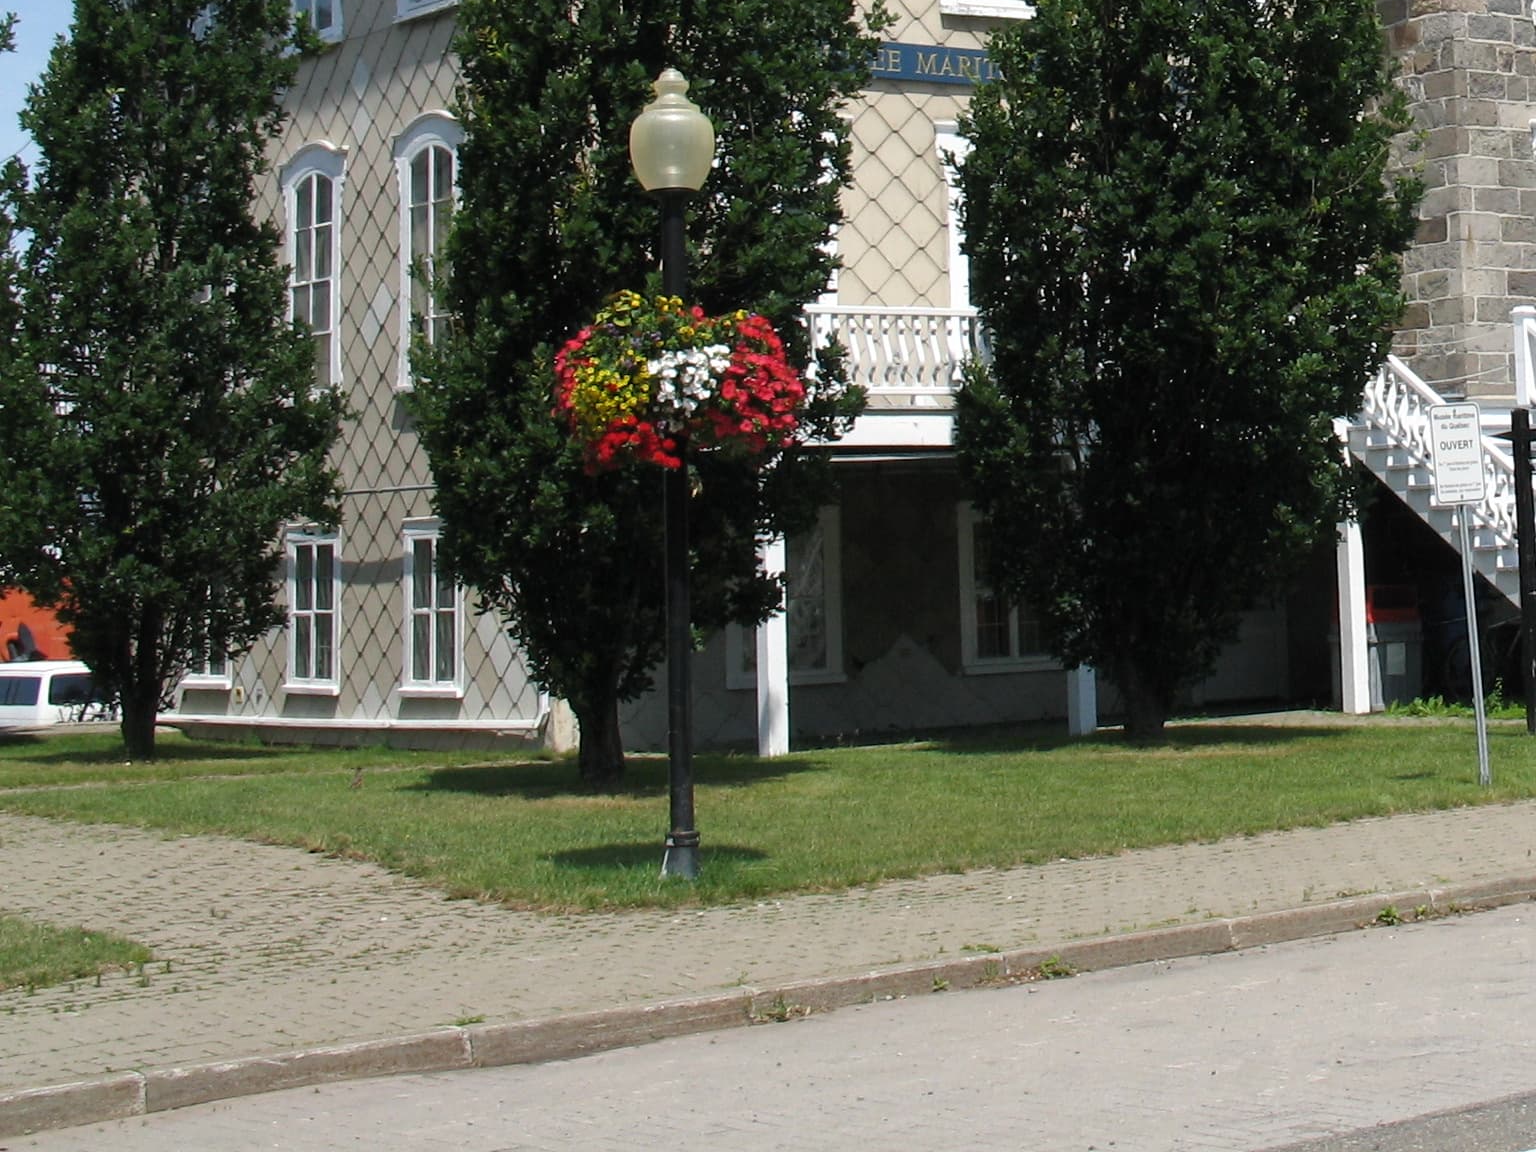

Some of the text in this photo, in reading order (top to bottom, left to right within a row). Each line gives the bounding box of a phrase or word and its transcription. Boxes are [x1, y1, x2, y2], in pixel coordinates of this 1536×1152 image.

[870, 48, 1007, 82] EE MARIT
[1440, 439, 1473, 450] OUVERT
